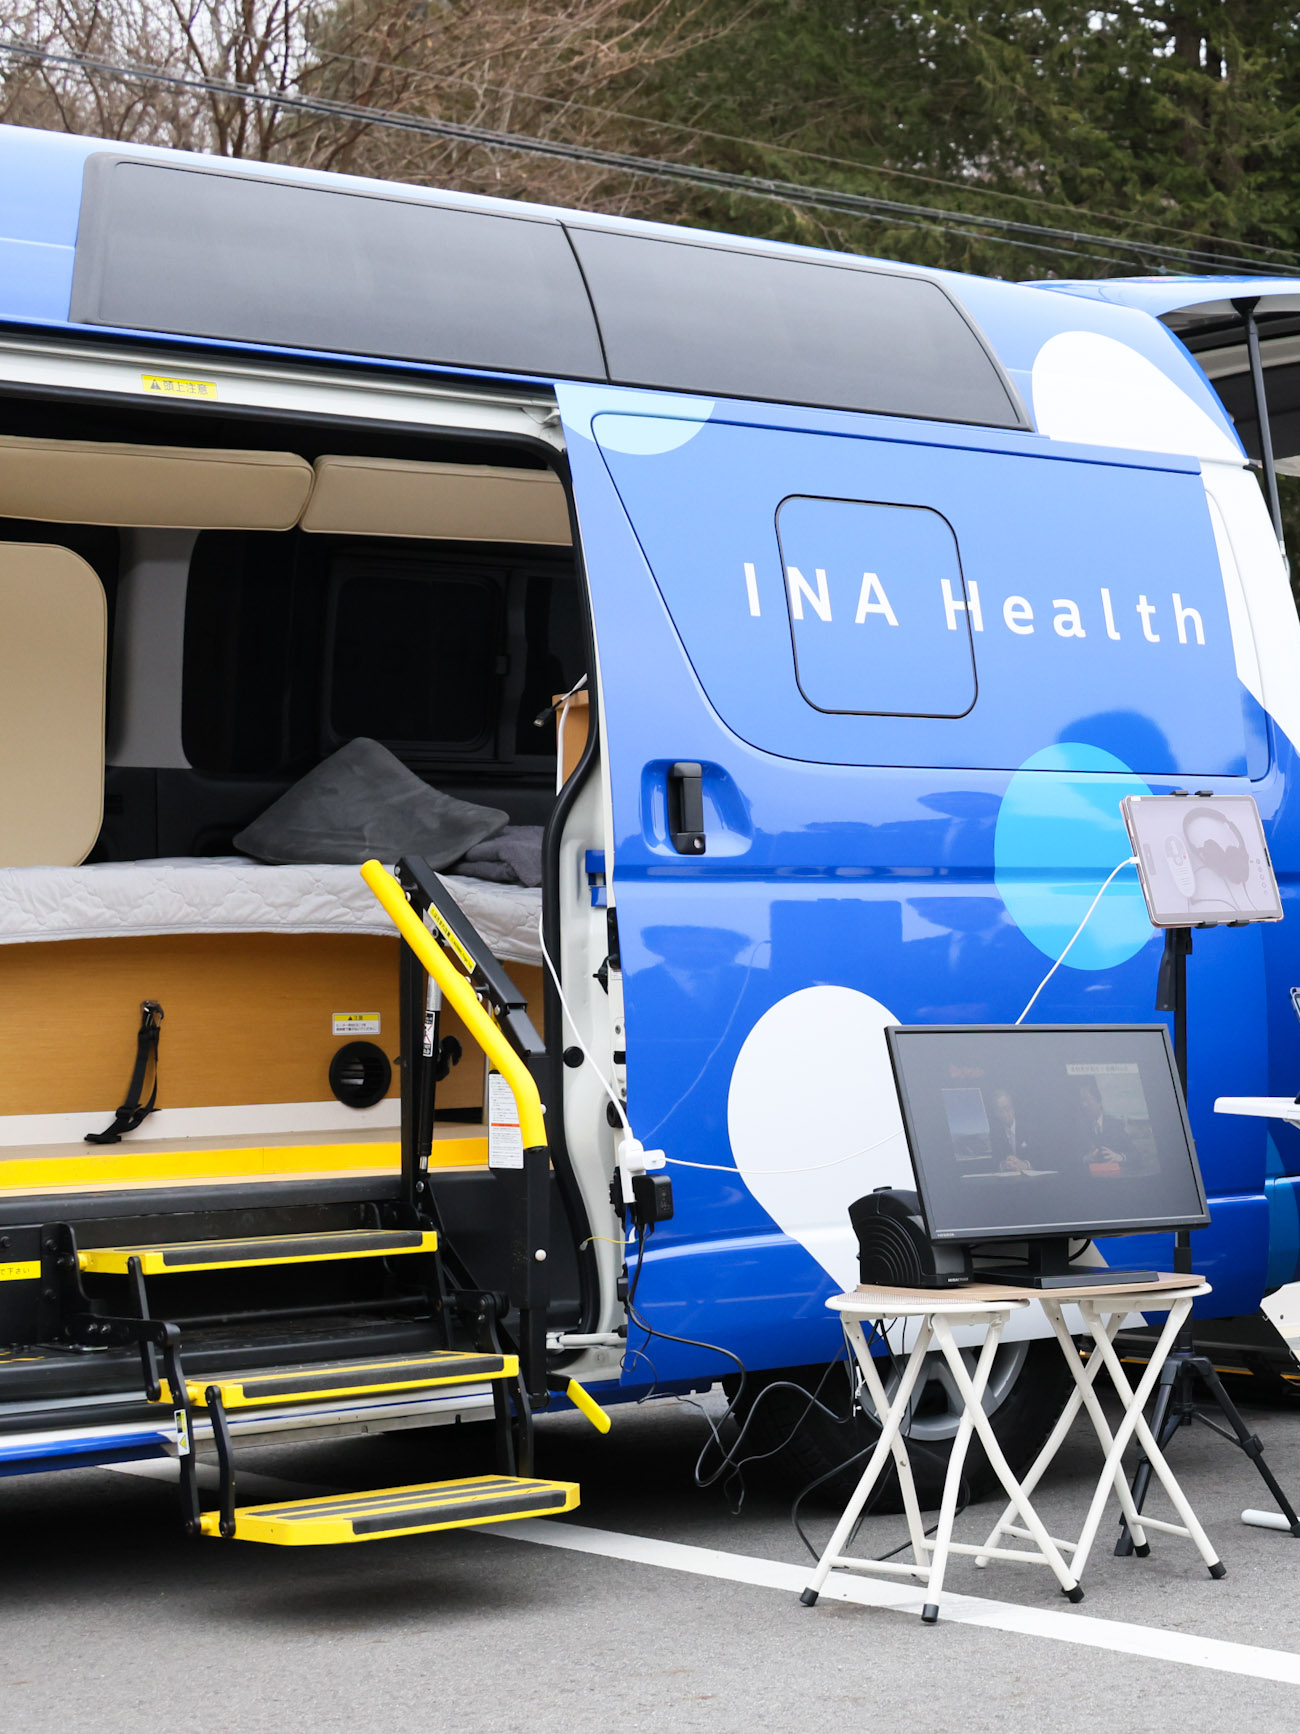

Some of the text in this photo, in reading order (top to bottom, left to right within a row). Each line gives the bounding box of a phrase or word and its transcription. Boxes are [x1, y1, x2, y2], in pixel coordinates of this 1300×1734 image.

[163, 380, 208, 395] 頭上注意
[743, 562, 1206, 645] INA Health
